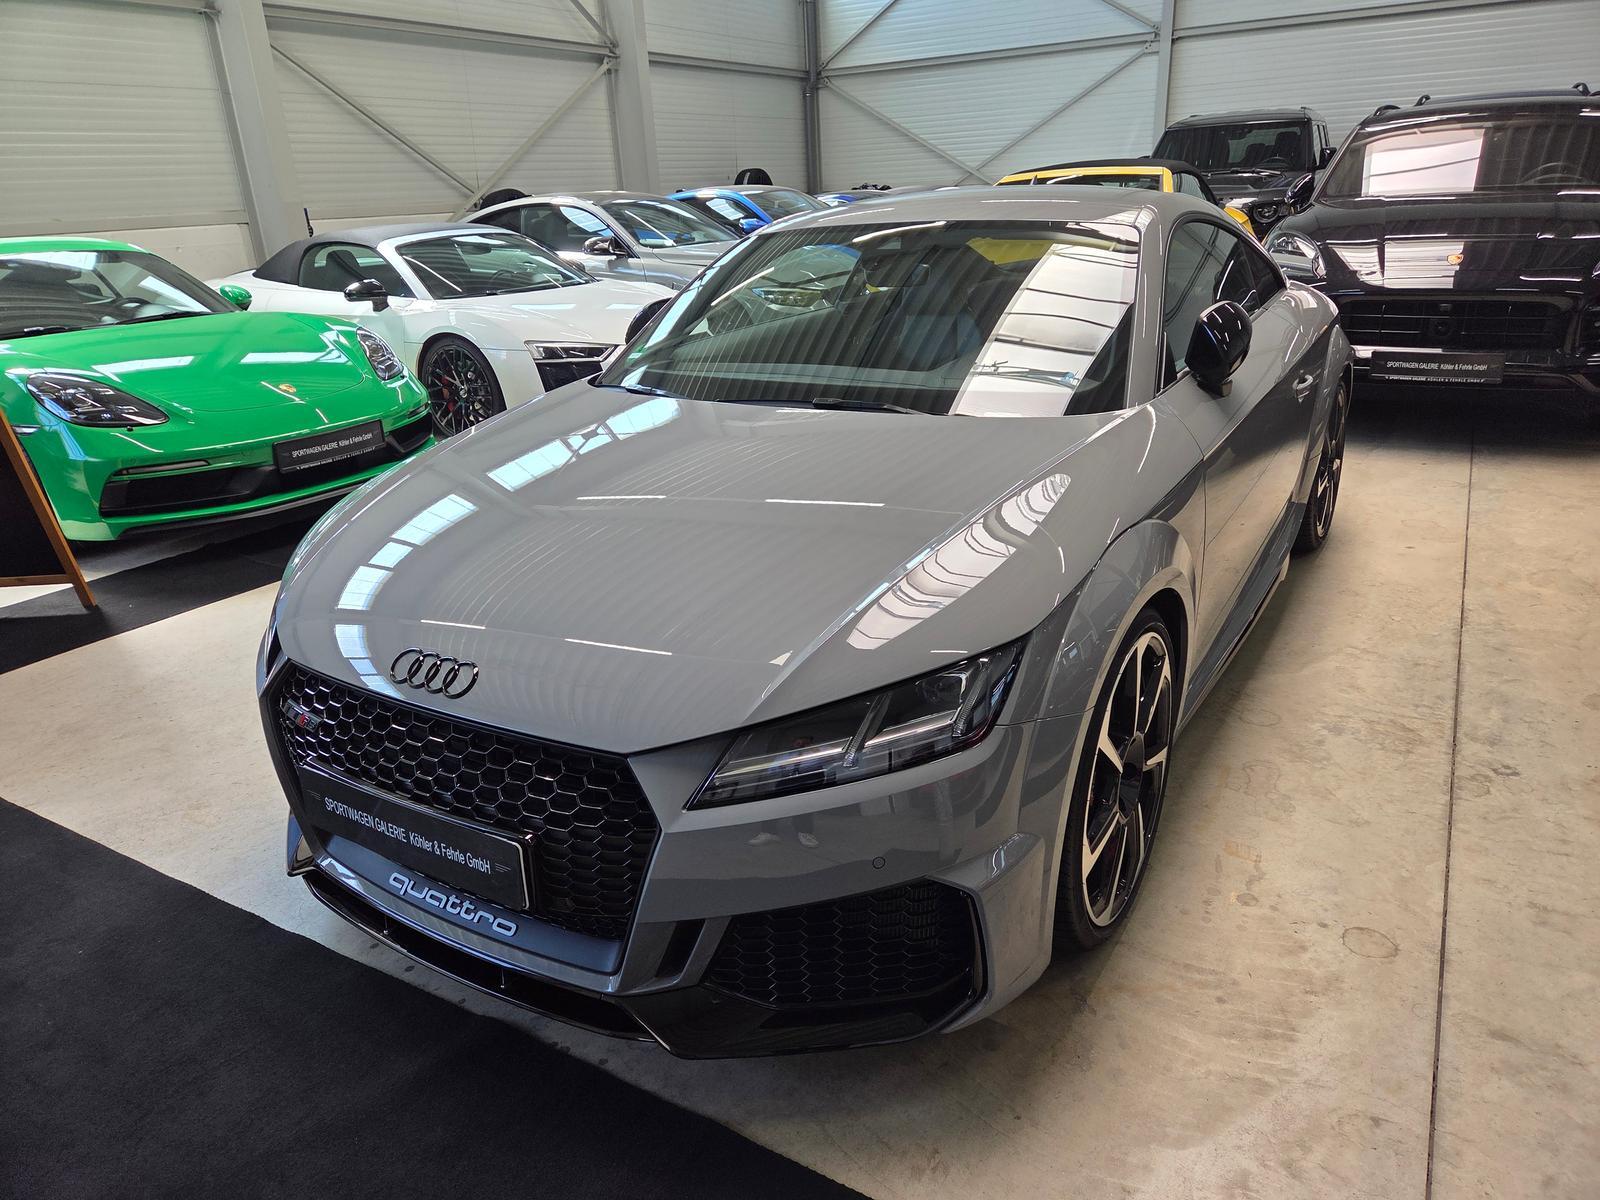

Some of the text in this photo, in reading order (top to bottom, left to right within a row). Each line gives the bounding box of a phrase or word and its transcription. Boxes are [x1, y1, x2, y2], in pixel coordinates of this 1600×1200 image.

[292, 446, 322, 458] SPORTWAGEN
[322, 442, 338, 451] GALERIE
[324, 797, 491, 874] SPORTWAGEN GALERIE Köhler & Fehrle GmbH
[389, 872, 518, 937] quattro
